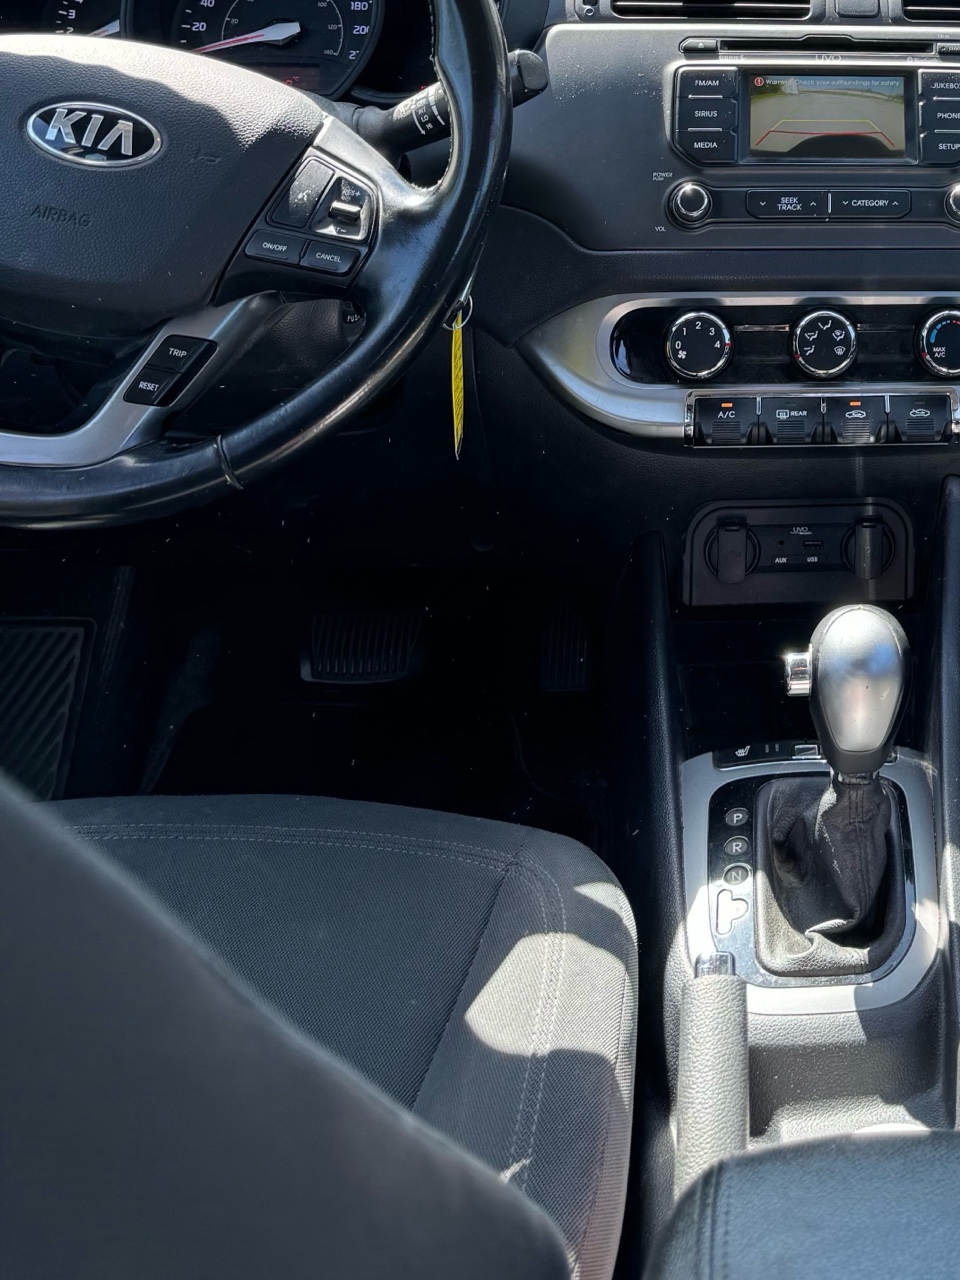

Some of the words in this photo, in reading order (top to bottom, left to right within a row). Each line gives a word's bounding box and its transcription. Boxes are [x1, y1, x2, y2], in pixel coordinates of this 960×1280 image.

[350, 1, 368, 11] 180
[68, 10, 75, 19] 3
[192, 22, 206, 31] 20
[45, 109, 133, 155] KIA
[30, 205, 92, 226] AIRBAG
[262, 242, 287, 252] ON/OFF
[316, 252, 341, 263] CANCEL
[695, 322, 701, 330] 2
[709, 327, 715, 336] 3
[675, 341, 681, 349] 0
[169, 348, 187, 358] TRIP
[139, 381, 159, 391] RESET
[733, 813, 743, 823] P
[732, 842, 742, 852] R
[731, 871, 742, 881] N
